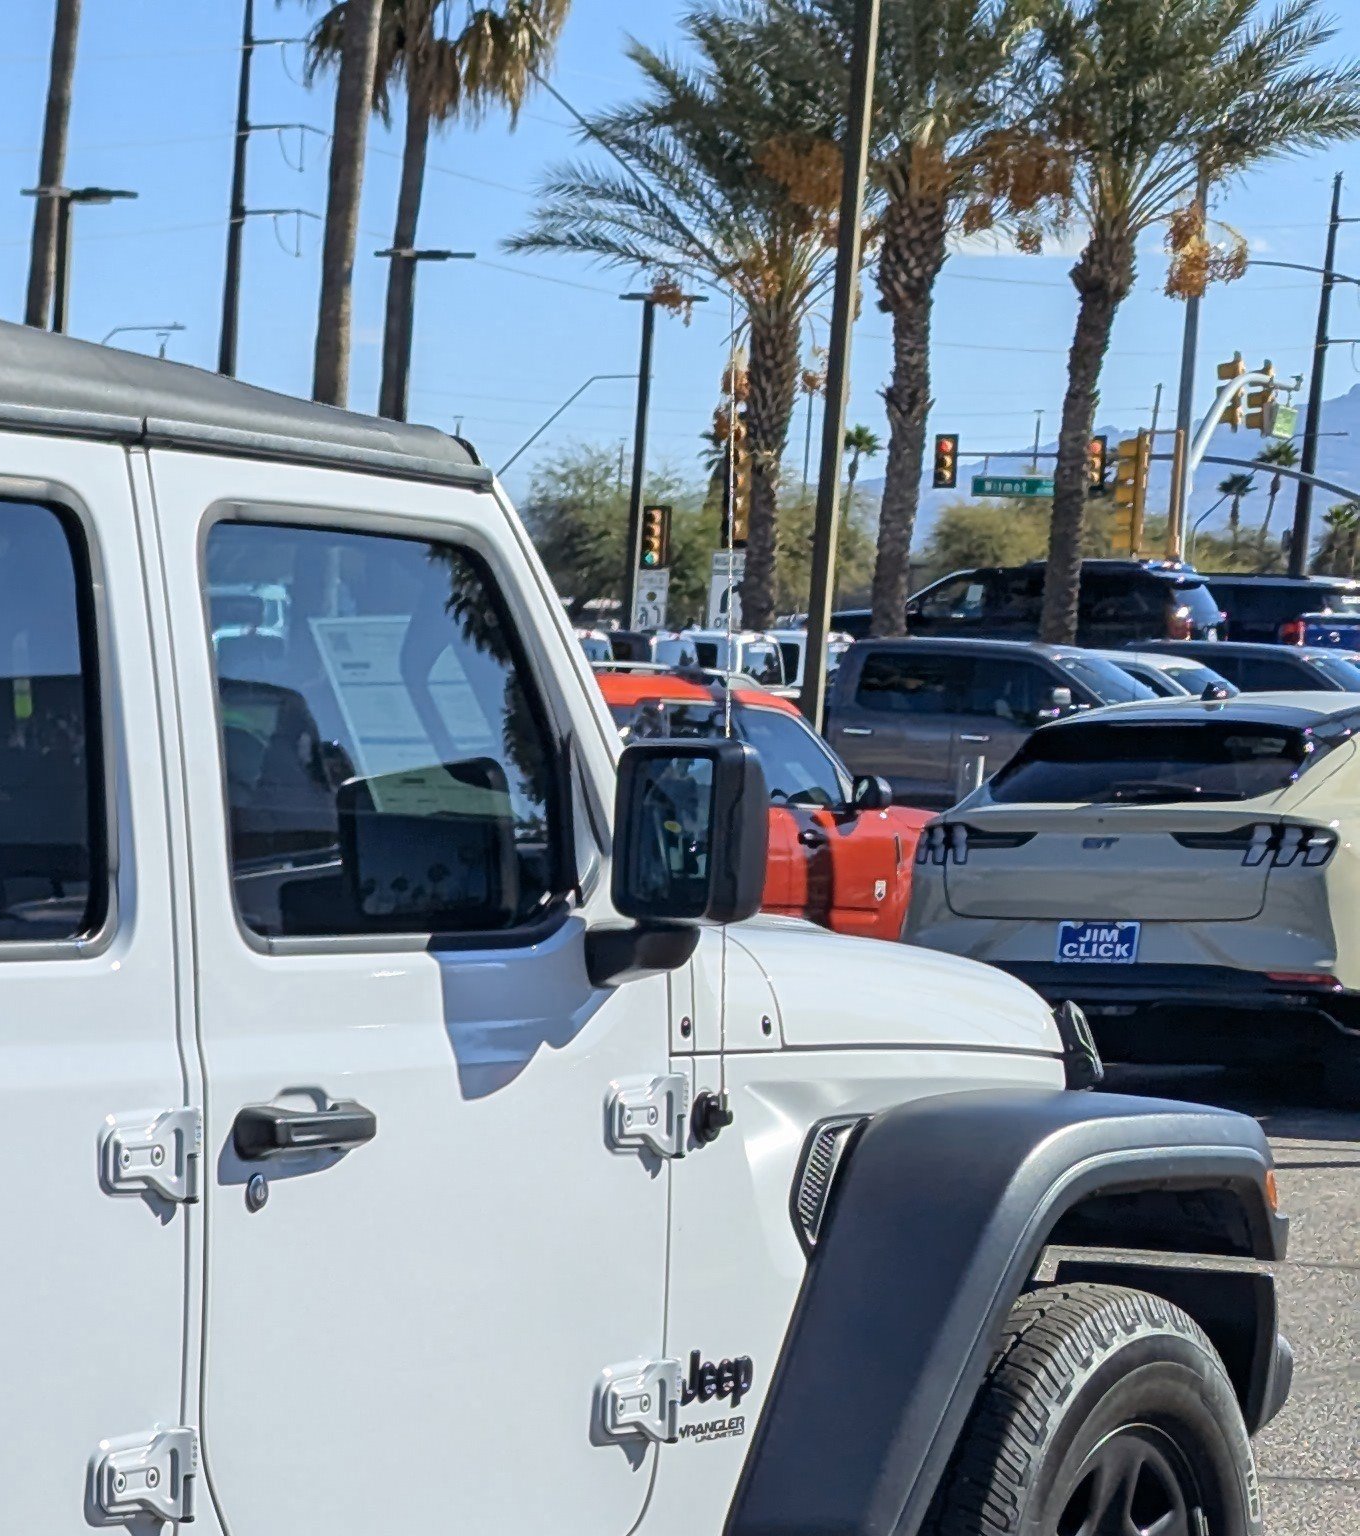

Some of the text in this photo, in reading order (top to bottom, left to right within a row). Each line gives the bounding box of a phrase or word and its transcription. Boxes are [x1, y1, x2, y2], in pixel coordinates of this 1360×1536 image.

[1078, 929, 1120, 942] JIM
[1062, 943, 1130, 957] CLICK
[680, 1349, 754, 1409] Jeep
[678, 1415, 746, 1439] WRANGLER
